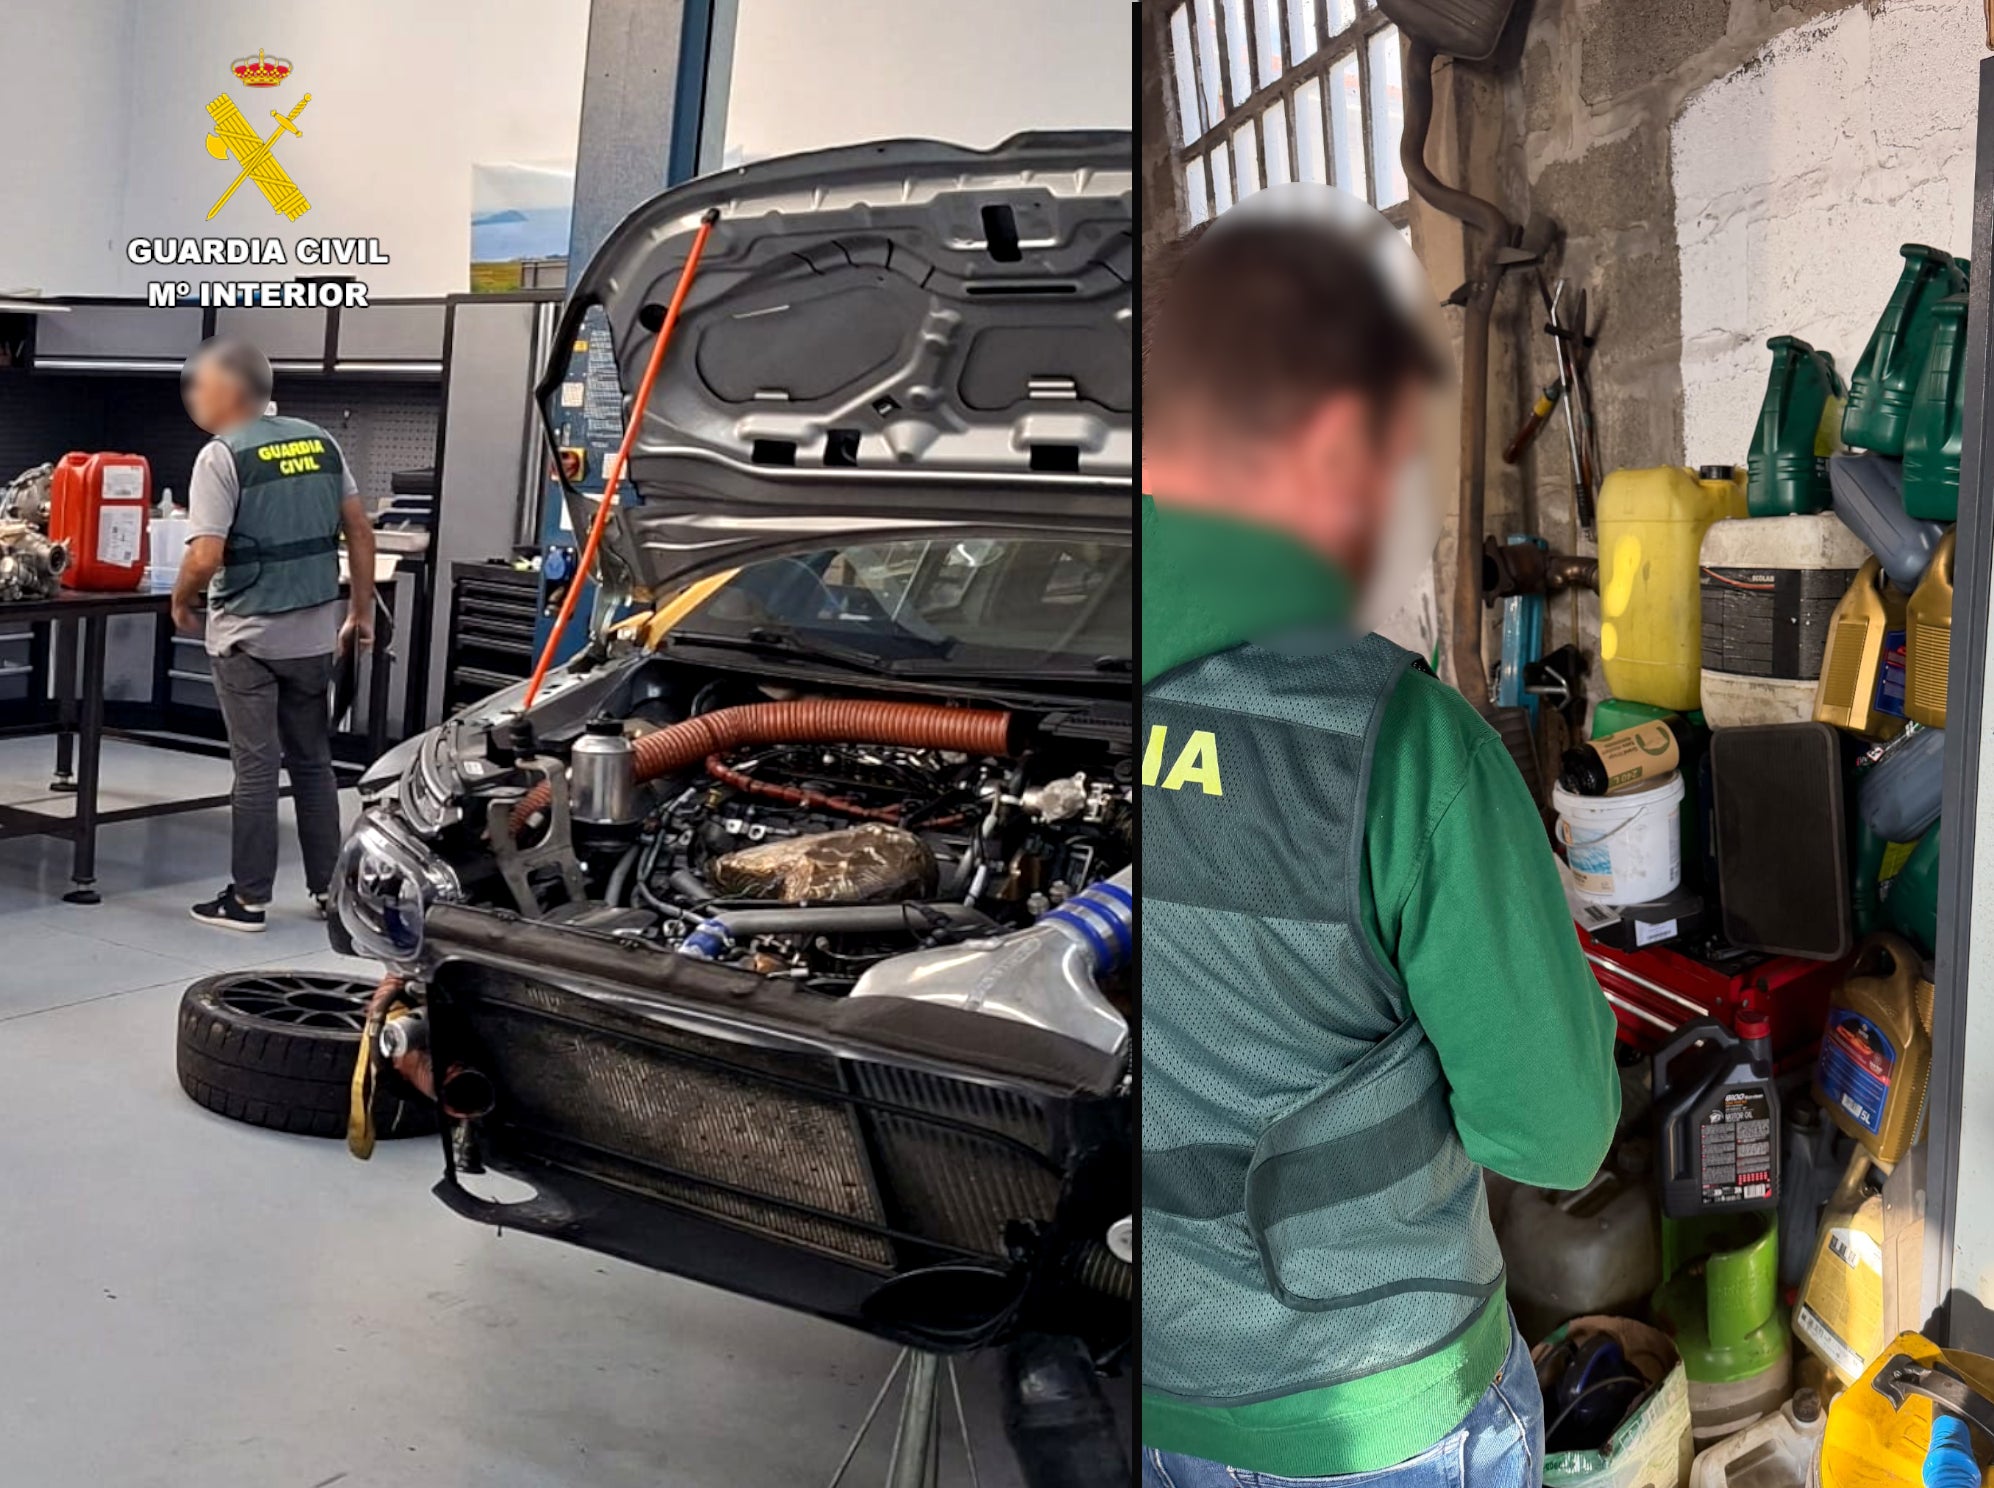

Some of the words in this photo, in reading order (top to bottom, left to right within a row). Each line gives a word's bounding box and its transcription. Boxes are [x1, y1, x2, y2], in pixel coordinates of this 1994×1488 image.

[257, 439, 325, 461] GUARDIA
[280, 455, 321, 475] CIVIL
[1860, 1108, 1871, 1125] 5L
